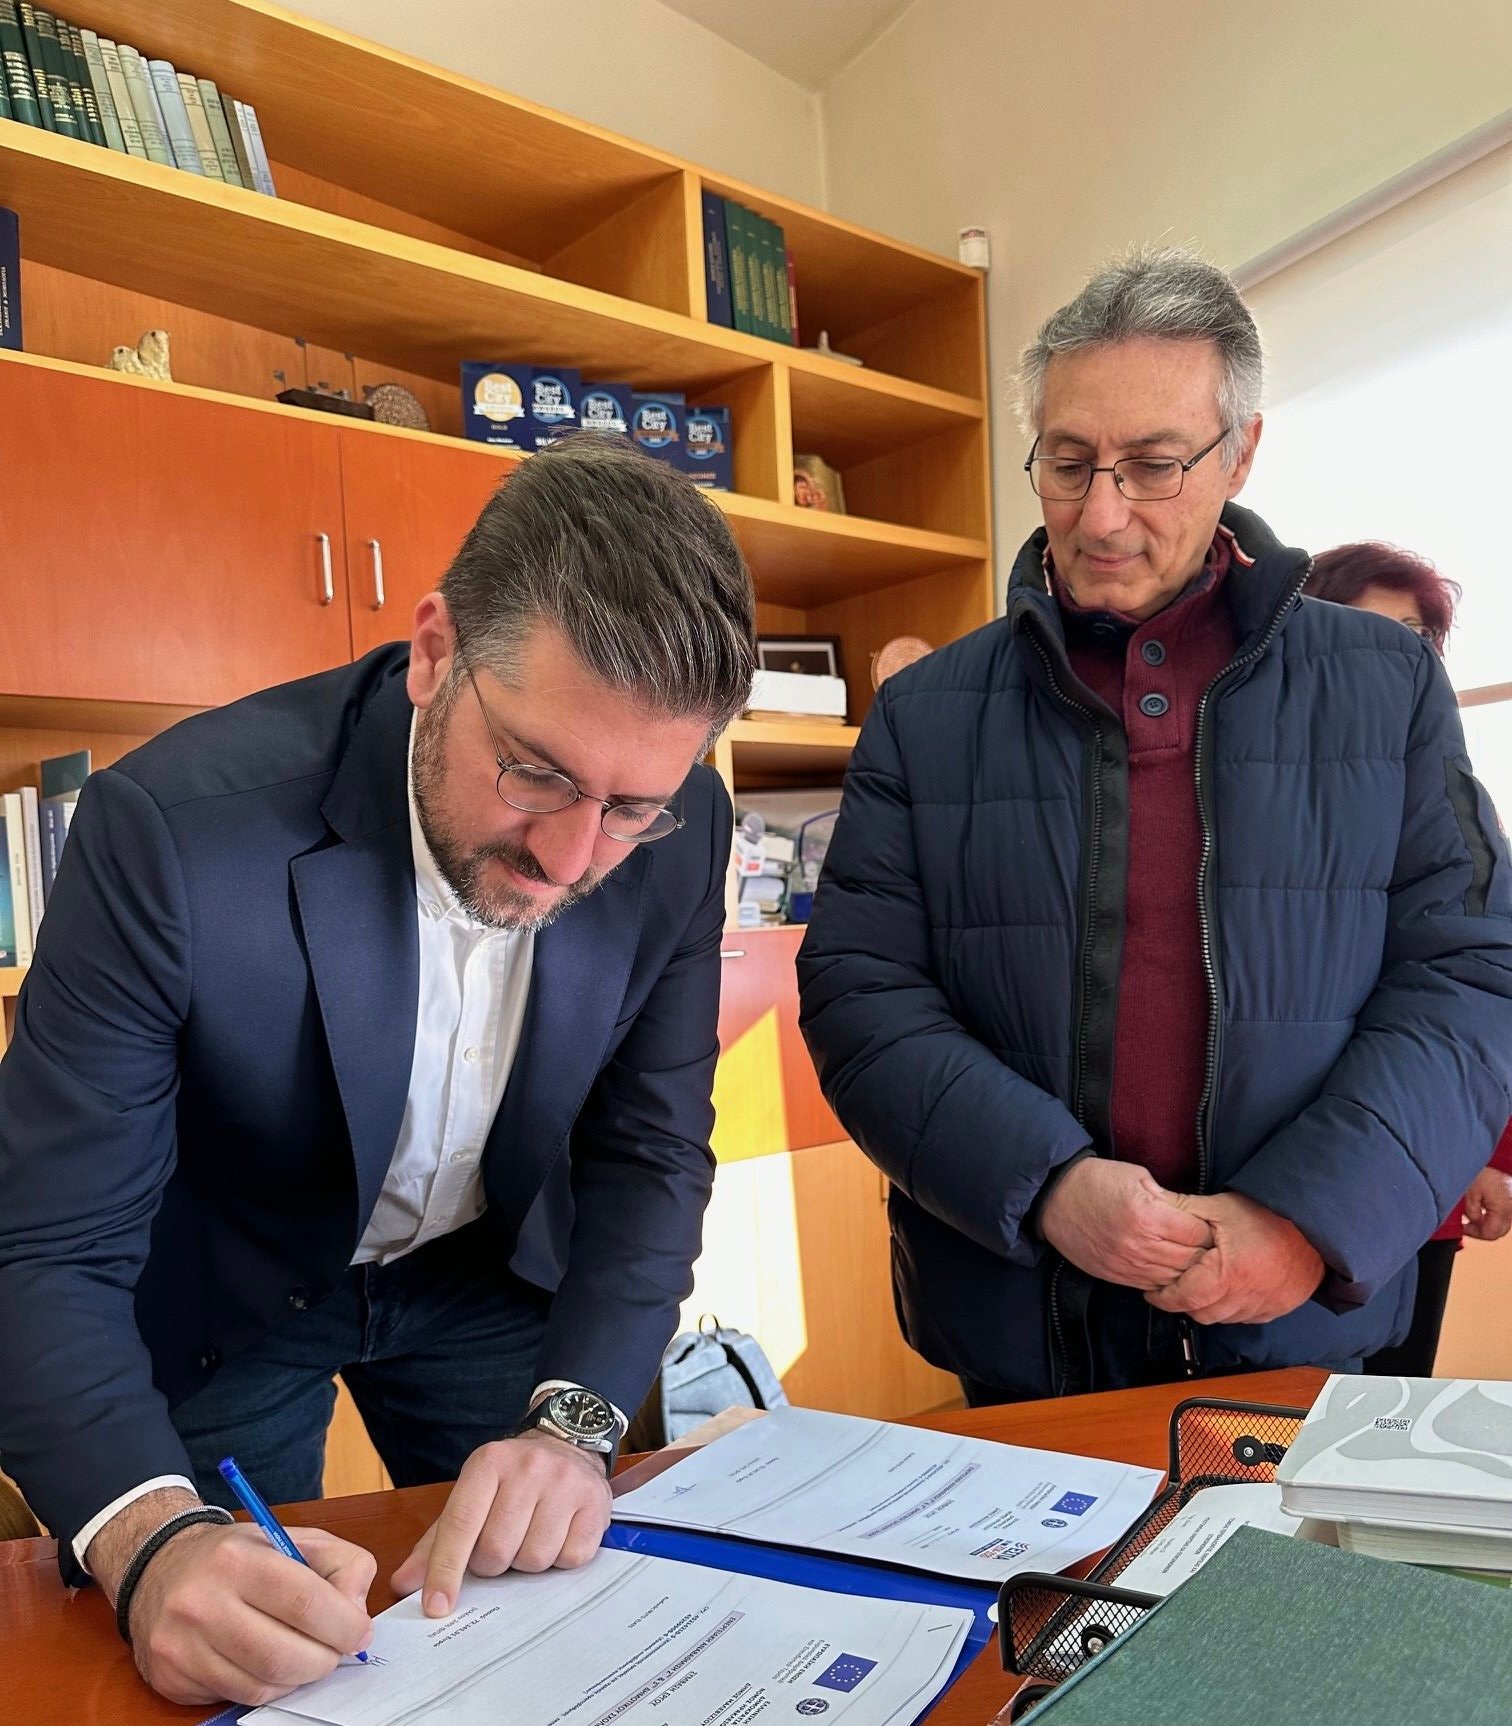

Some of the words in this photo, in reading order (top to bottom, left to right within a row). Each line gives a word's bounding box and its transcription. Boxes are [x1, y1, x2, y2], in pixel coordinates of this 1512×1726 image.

[535, 383, 562, 395] Best
[535, 394, 562, 405] City
[588, 398, 613, 410] Best
[588, 409, 614, 420] City
[642, 409, 667, 421] Best
[642, 420, 668, 432] City
[688, 423, 713, 434] Best
[688, 433, 714, 444] City
[273, 1531, 282, 1542] INDIA
[283, 1544, 292, 1557] MADE
[993, 1548, 1026, 1560] ΕΣΠΑ
[706, 1616, 737, 1642] ΕΝΕΡΓΕΙΑΚΗ
[671, 1642, 708, 1670] ΑΝΑΒΑΘΜΙΣΗ
[804, 1643, 831, 1668] ΕΥΡΩΠΑΪΚΗ
[669, 1670, 698, 1691] ΣΥΜΒΑΣΗ
[787, 1668, 806, 1683] ΕΝΩΣΗ
[732, 1682, 754, 1698] ΔΗΜΟΣ
[746, 1687, 767, 1703] ΝΟΜΟΣ
[613, 1687, 652, 1714] ΔΗΜΟΤΙΚΟΥ
[649, 1692, 671, 1706] ΕΡΓΟΥ
[699, 1698, 735, 1726] ΜΑΛΕΒΙΖΙΟΥ
[719, 1703, 748, 1726] ΗΡΑΚΛΕΙΟ
[732, 1695, 768, 1725] ΔΗΜΟΚΡΑΤΙΑ
[742, 1700, 771, 1724] ΕΛΛΗΝΙΚΗ
[595, 1712, 618, 1726] ΣΧΟΛ
